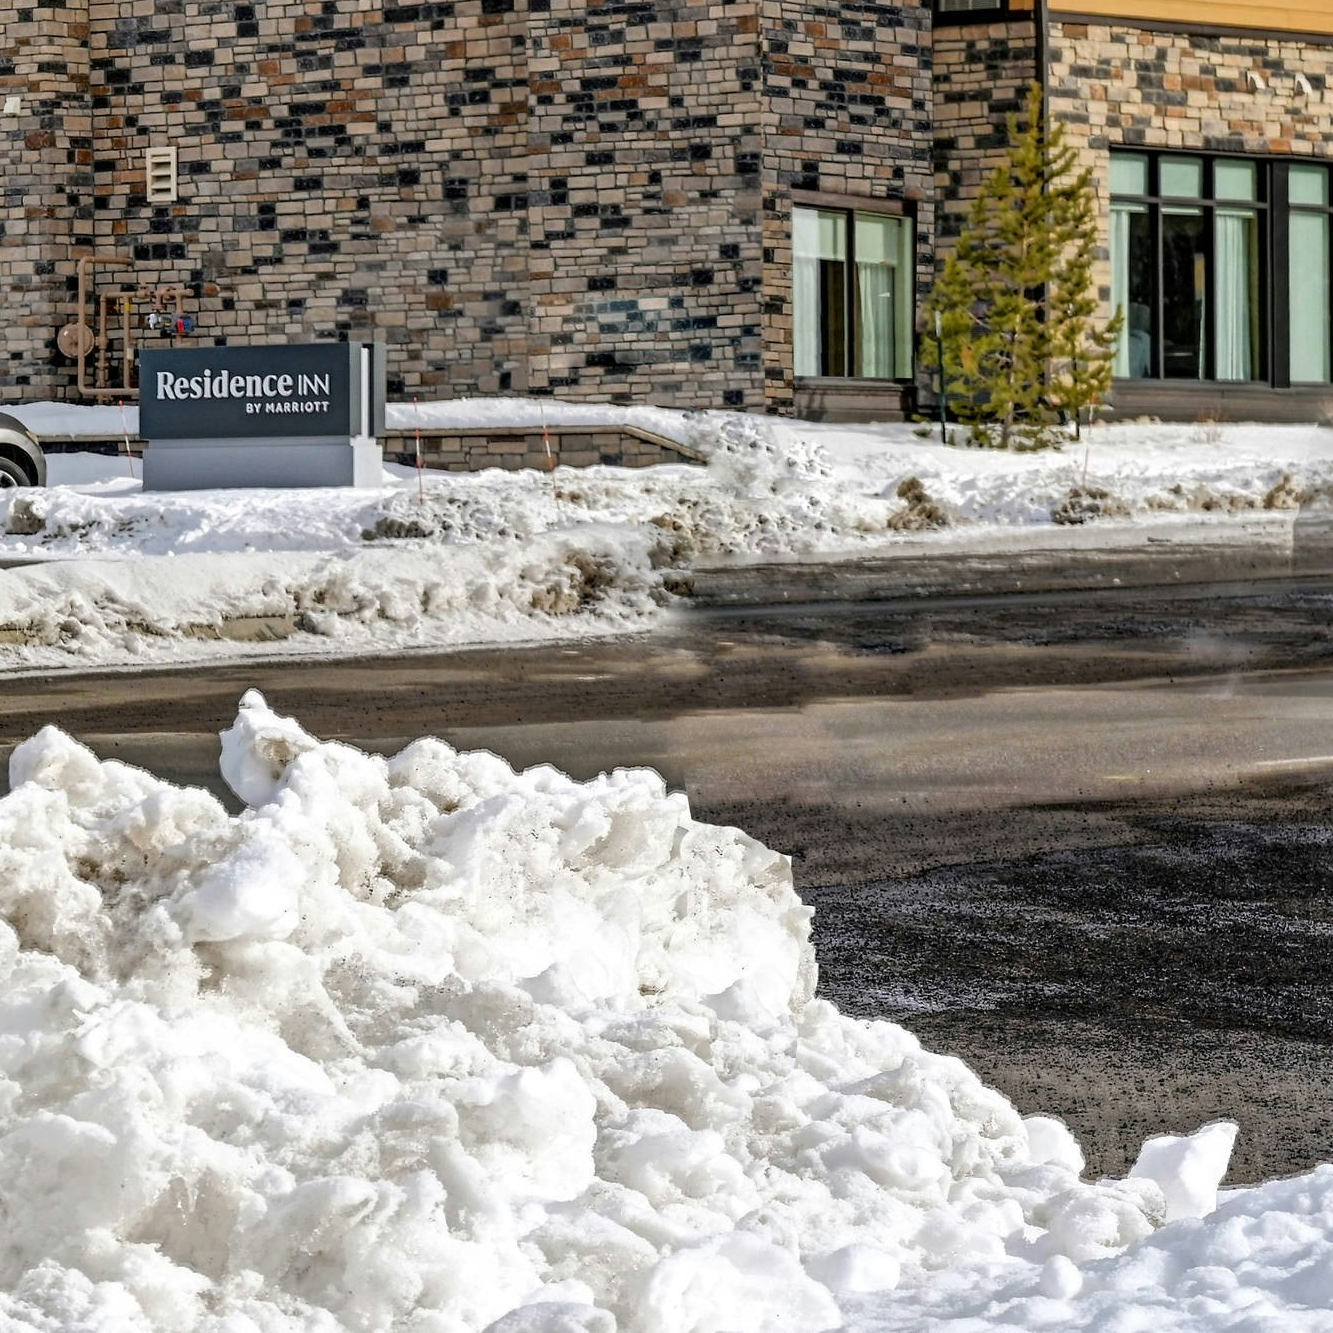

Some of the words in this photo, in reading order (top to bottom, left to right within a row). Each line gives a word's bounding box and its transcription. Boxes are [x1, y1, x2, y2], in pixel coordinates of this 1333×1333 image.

[156, 369, 293, 400] Residence
[298, 374, 330, 396] INN
[245, 402, 261, 414] BY
[265, 401, 329, 414] MARRIOTT
